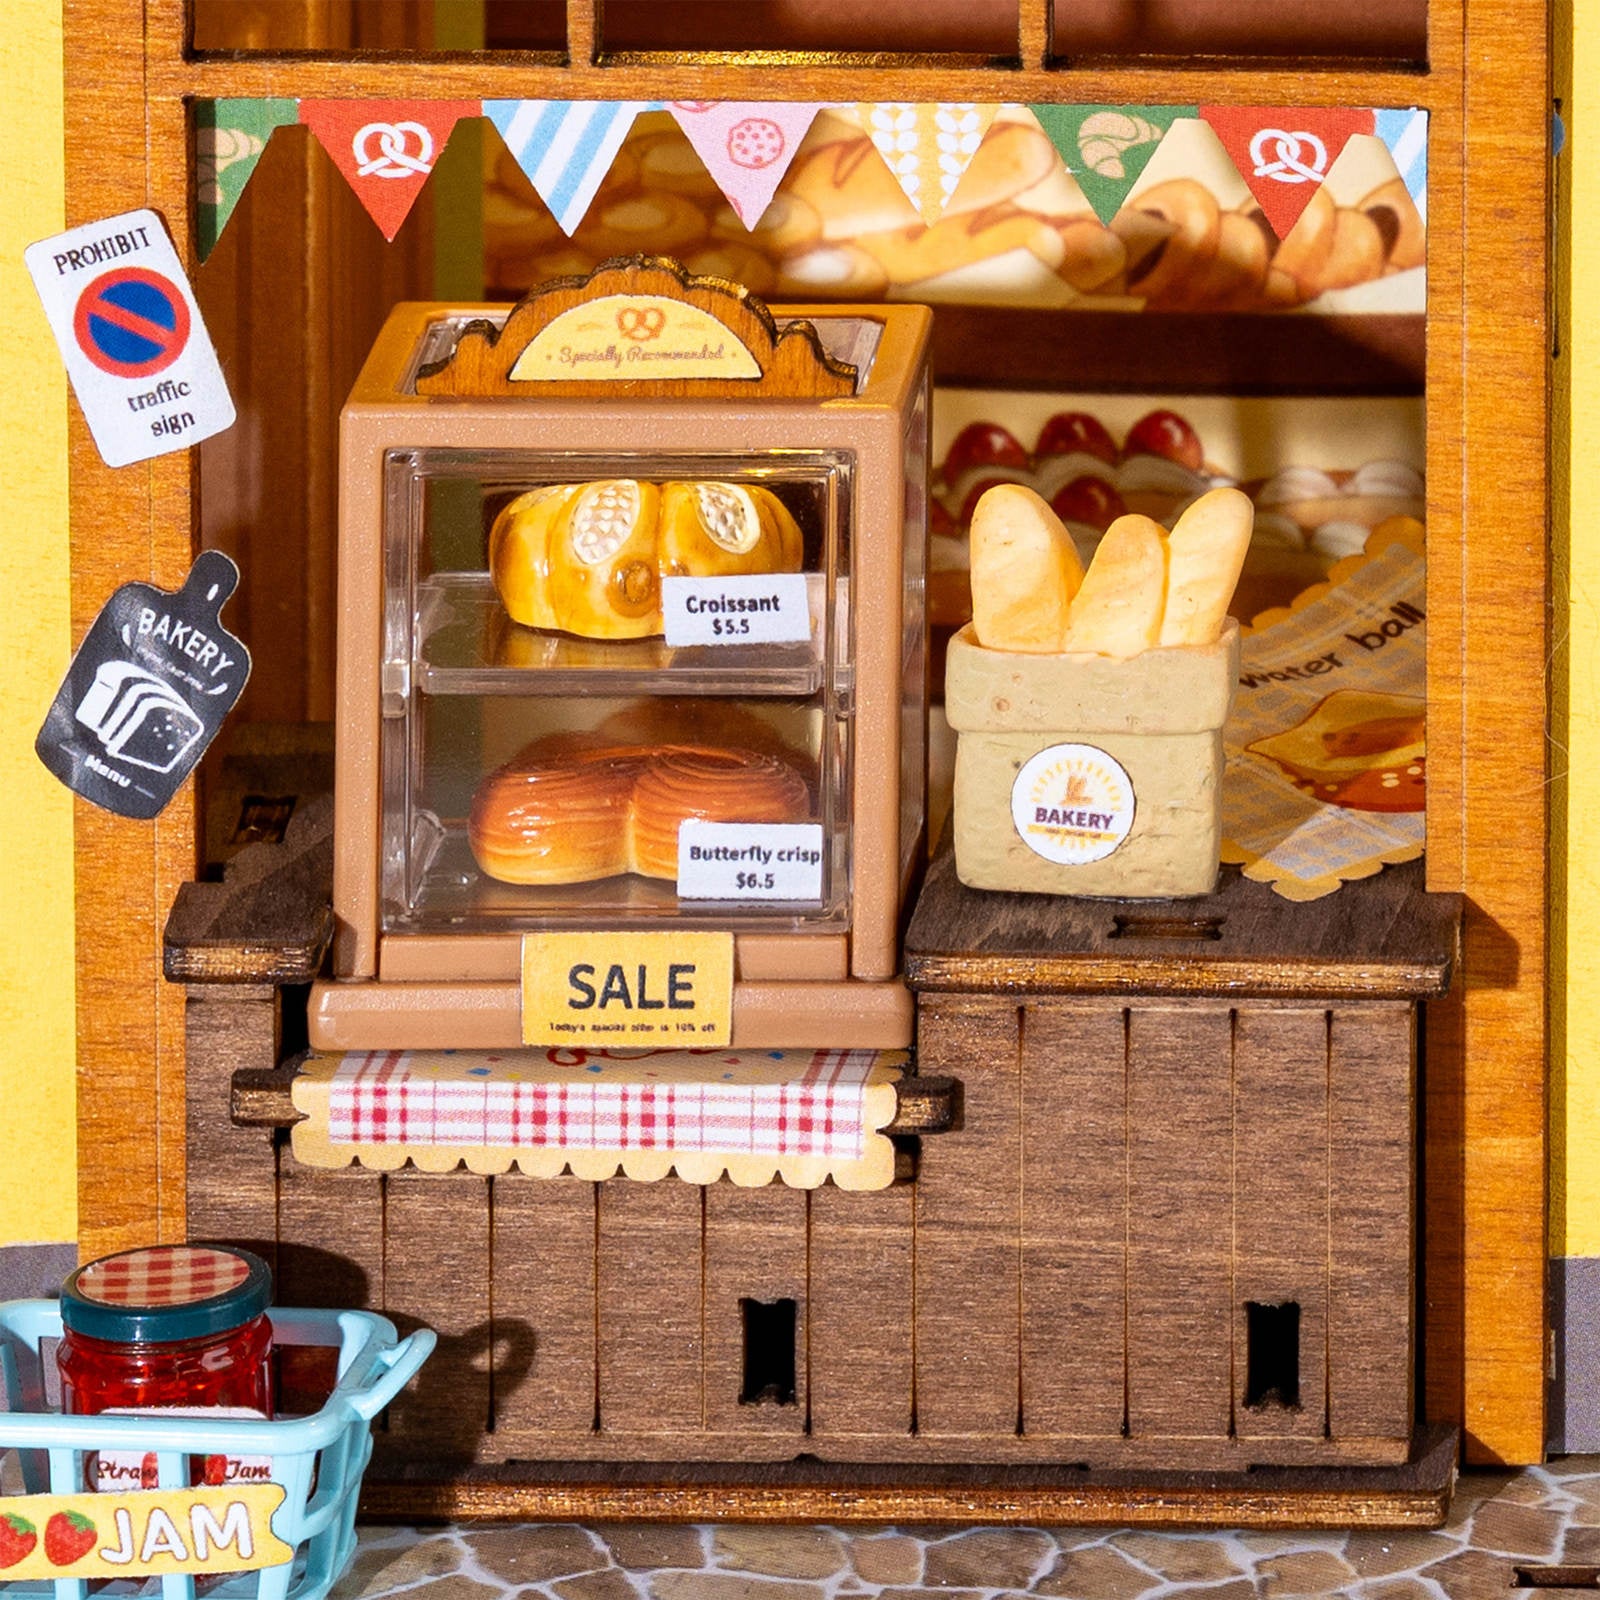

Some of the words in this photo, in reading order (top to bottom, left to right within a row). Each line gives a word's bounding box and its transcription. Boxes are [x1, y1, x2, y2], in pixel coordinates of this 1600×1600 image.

[53, 227, 151, 275] PROHIBIT
[559, 345, 623, 369] Specially
[127, 380, 192, 412] traffic
[150, 411, 195, 437] sign
[686, 594, 780, 613] Croissant
[138, 607, 235, 677] BAKERY
[1034, 807, 1114, 830] BAKERY
[690, 846, 773, 864] Butterfly
[777, 847, 820, 865] crisp
[736, 872, 775, 890] $6.5
[568, 964, 696, 1010] SALE
[100, 1501, 253, 1564] JAM
